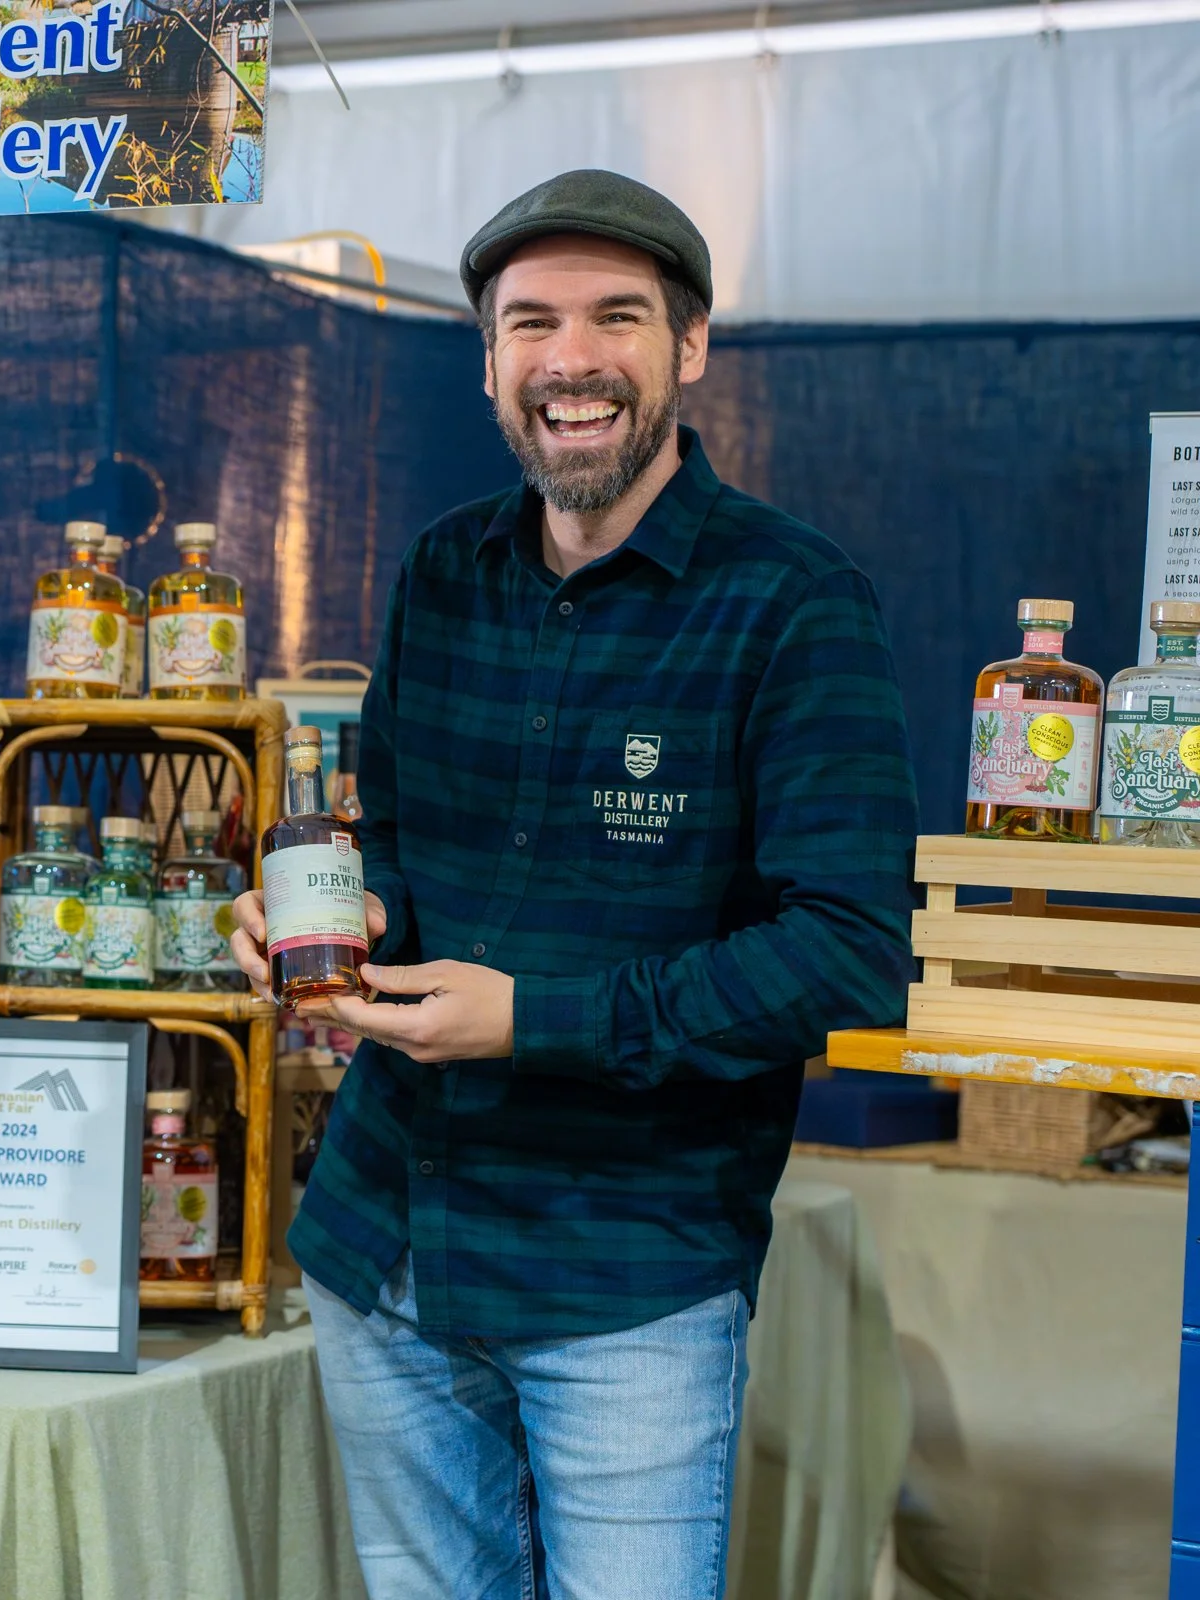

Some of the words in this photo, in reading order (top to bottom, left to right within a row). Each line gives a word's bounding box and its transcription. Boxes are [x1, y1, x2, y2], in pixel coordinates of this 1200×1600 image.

[1172, 481, 1193, 491] LAST
[1169, 527, 1189, 537] LAST
[1165, 575, 1185, 584] LAST
[1188, 575, 1200, 584] SA
[1031, 728, 1070, 749] CONSCIOUS
[1040, 725, 1061, 738] CLEAN
[992, 738, 1025, 759] Last
[971, 755, 1051, 782] Sanctuary
[1140, 751, 1177, 774] Last
[1112, 768, 1200, 799] Sanctuary
[593, 790, 688, 813] DERWENT
[1135, 797, 1165, 809] ORGANIC
[1165, 799, 1178, 808] GIN
[604, 812, 669, 828] DISTILLERY
[606, 830, 664, 844] TASMANIA
[338, 864, 351, 874] THE
[307, 873, 364, 892] DERWEN
[8, 1103, 34, 1113] Fair
[1, 1123, 37, 1136] 2024
[18, 1218, 82, 1233] Distillery
[49, 1261, 77, 1271] Rotary
